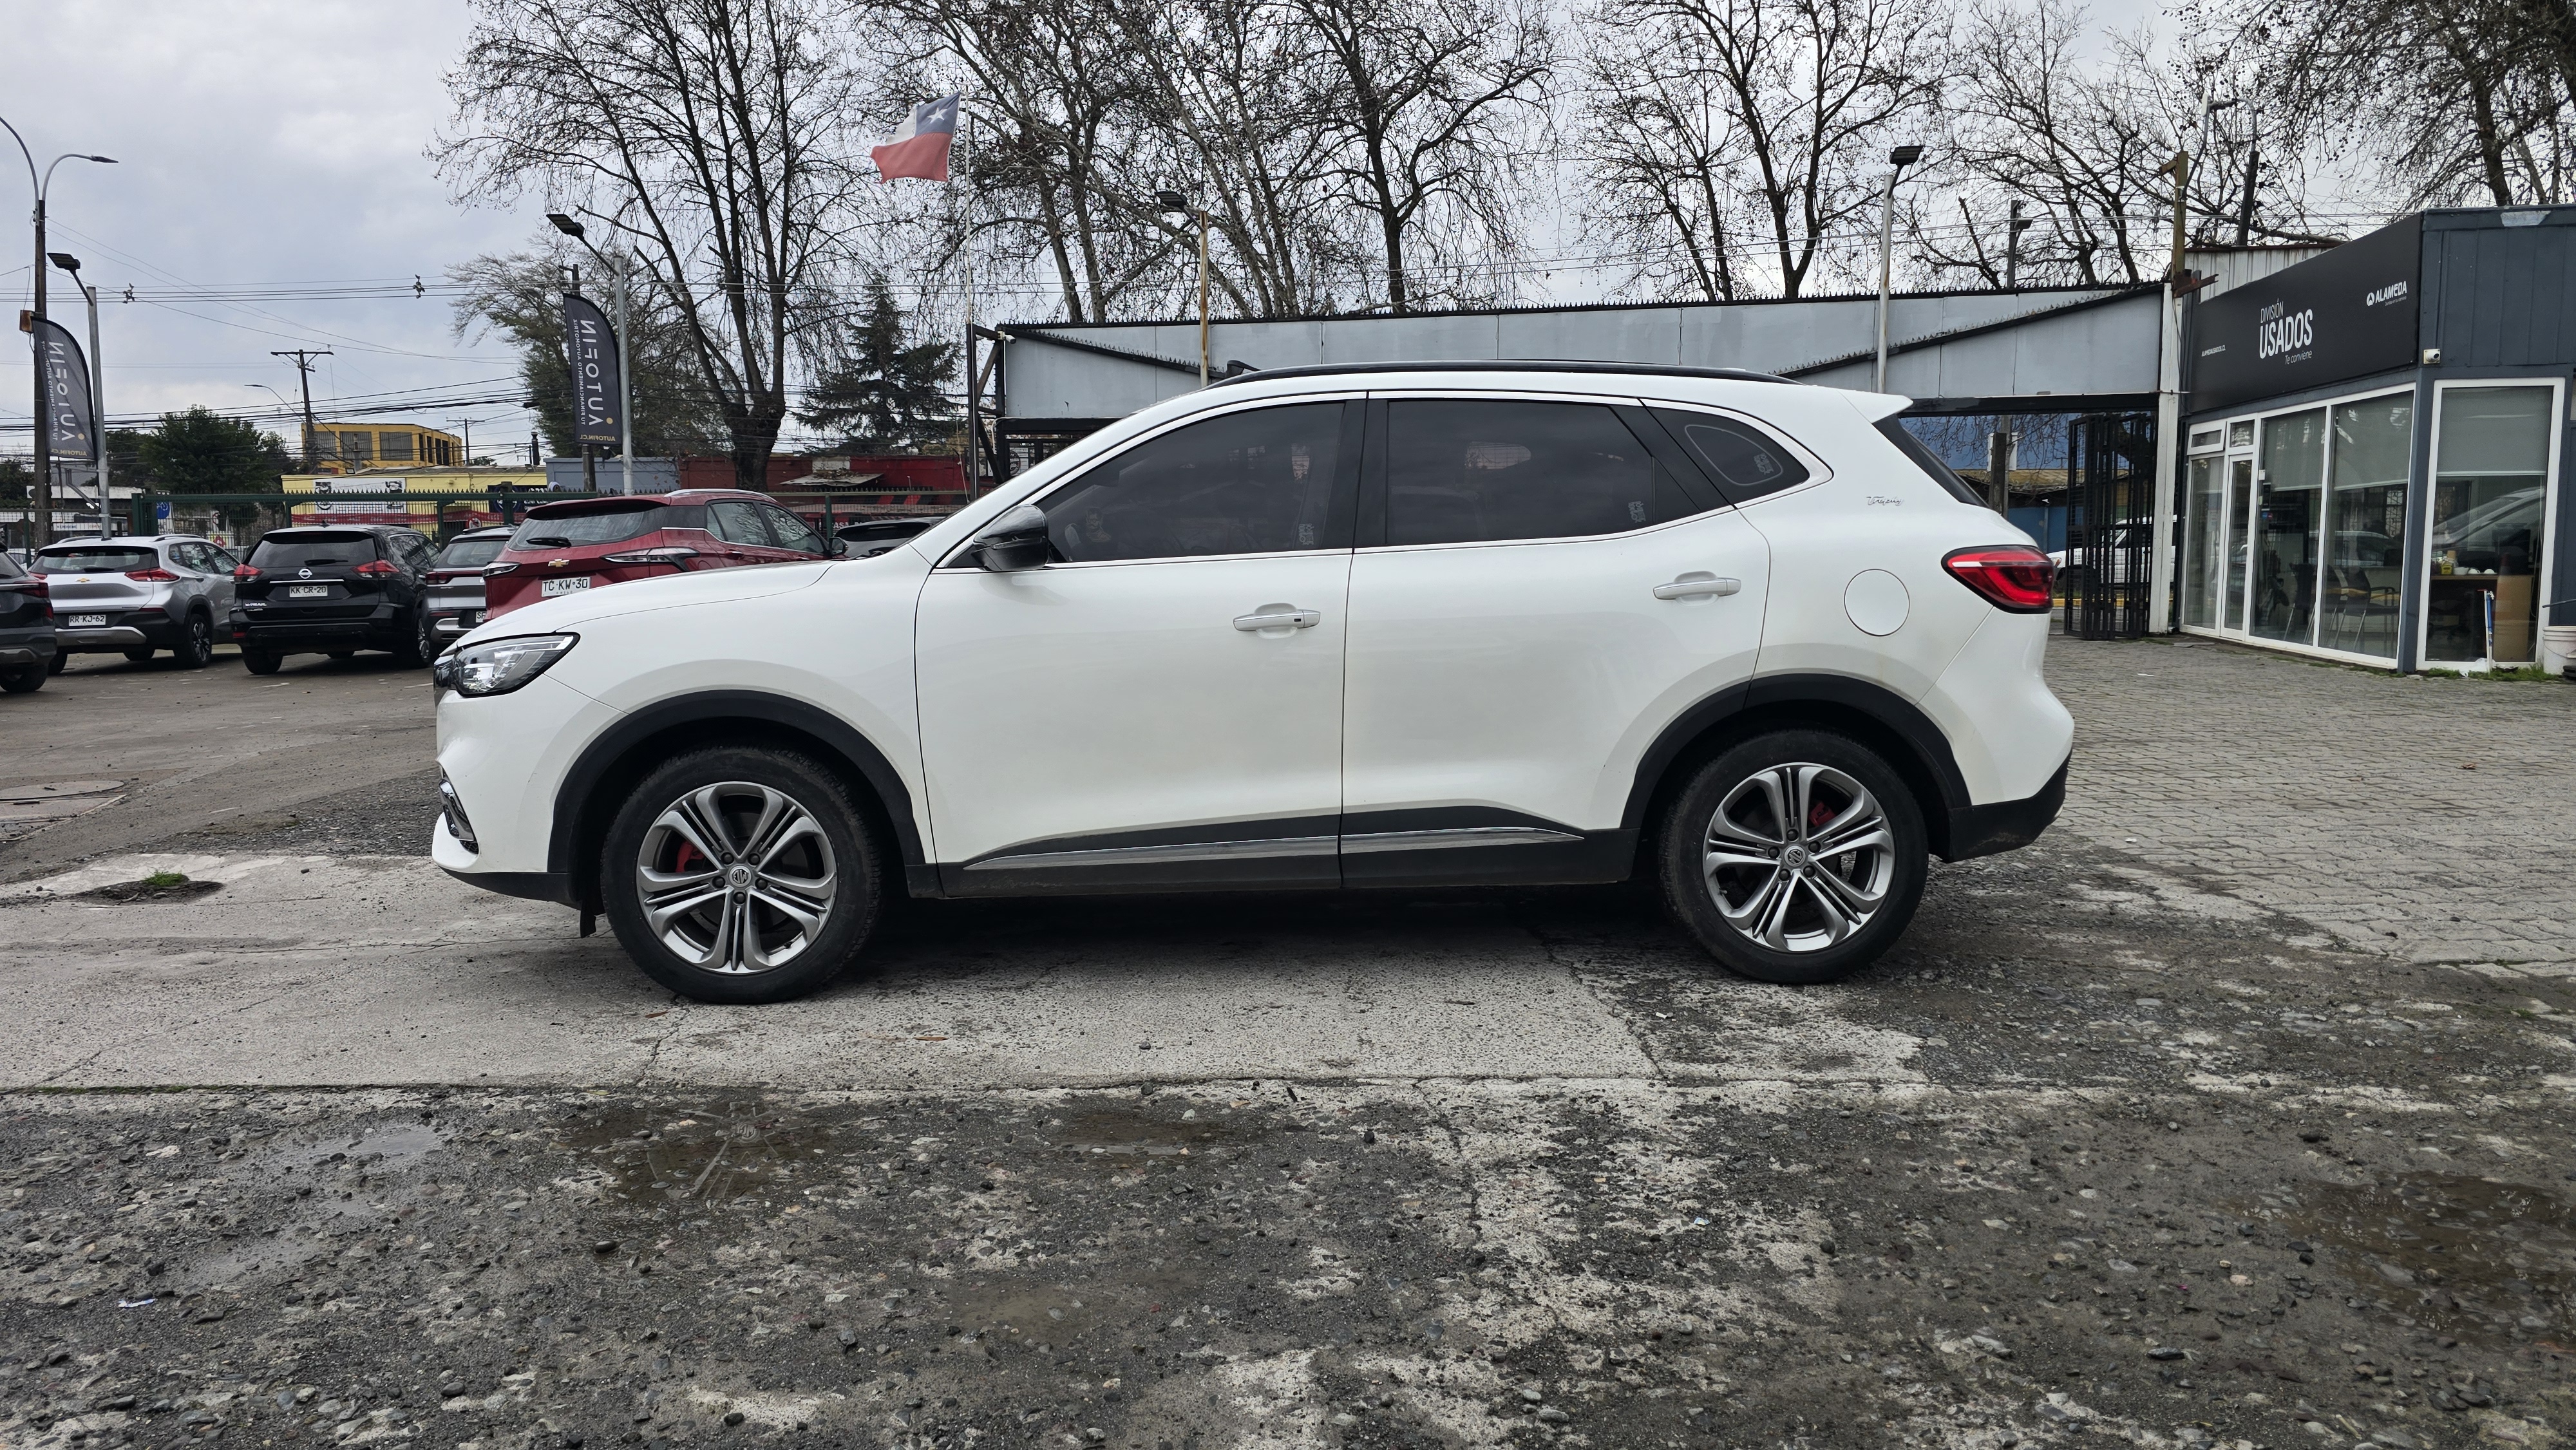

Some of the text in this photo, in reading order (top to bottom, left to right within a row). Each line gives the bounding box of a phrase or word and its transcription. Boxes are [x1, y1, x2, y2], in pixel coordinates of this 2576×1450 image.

[2375, 281, 2407, 303] ALAMEDA
[2260, 298, 2284, 324] DIVISIÓN
[2259, 309, 2313, 359] USADOS
[2285, 350, 2312, 364] Te conviene
